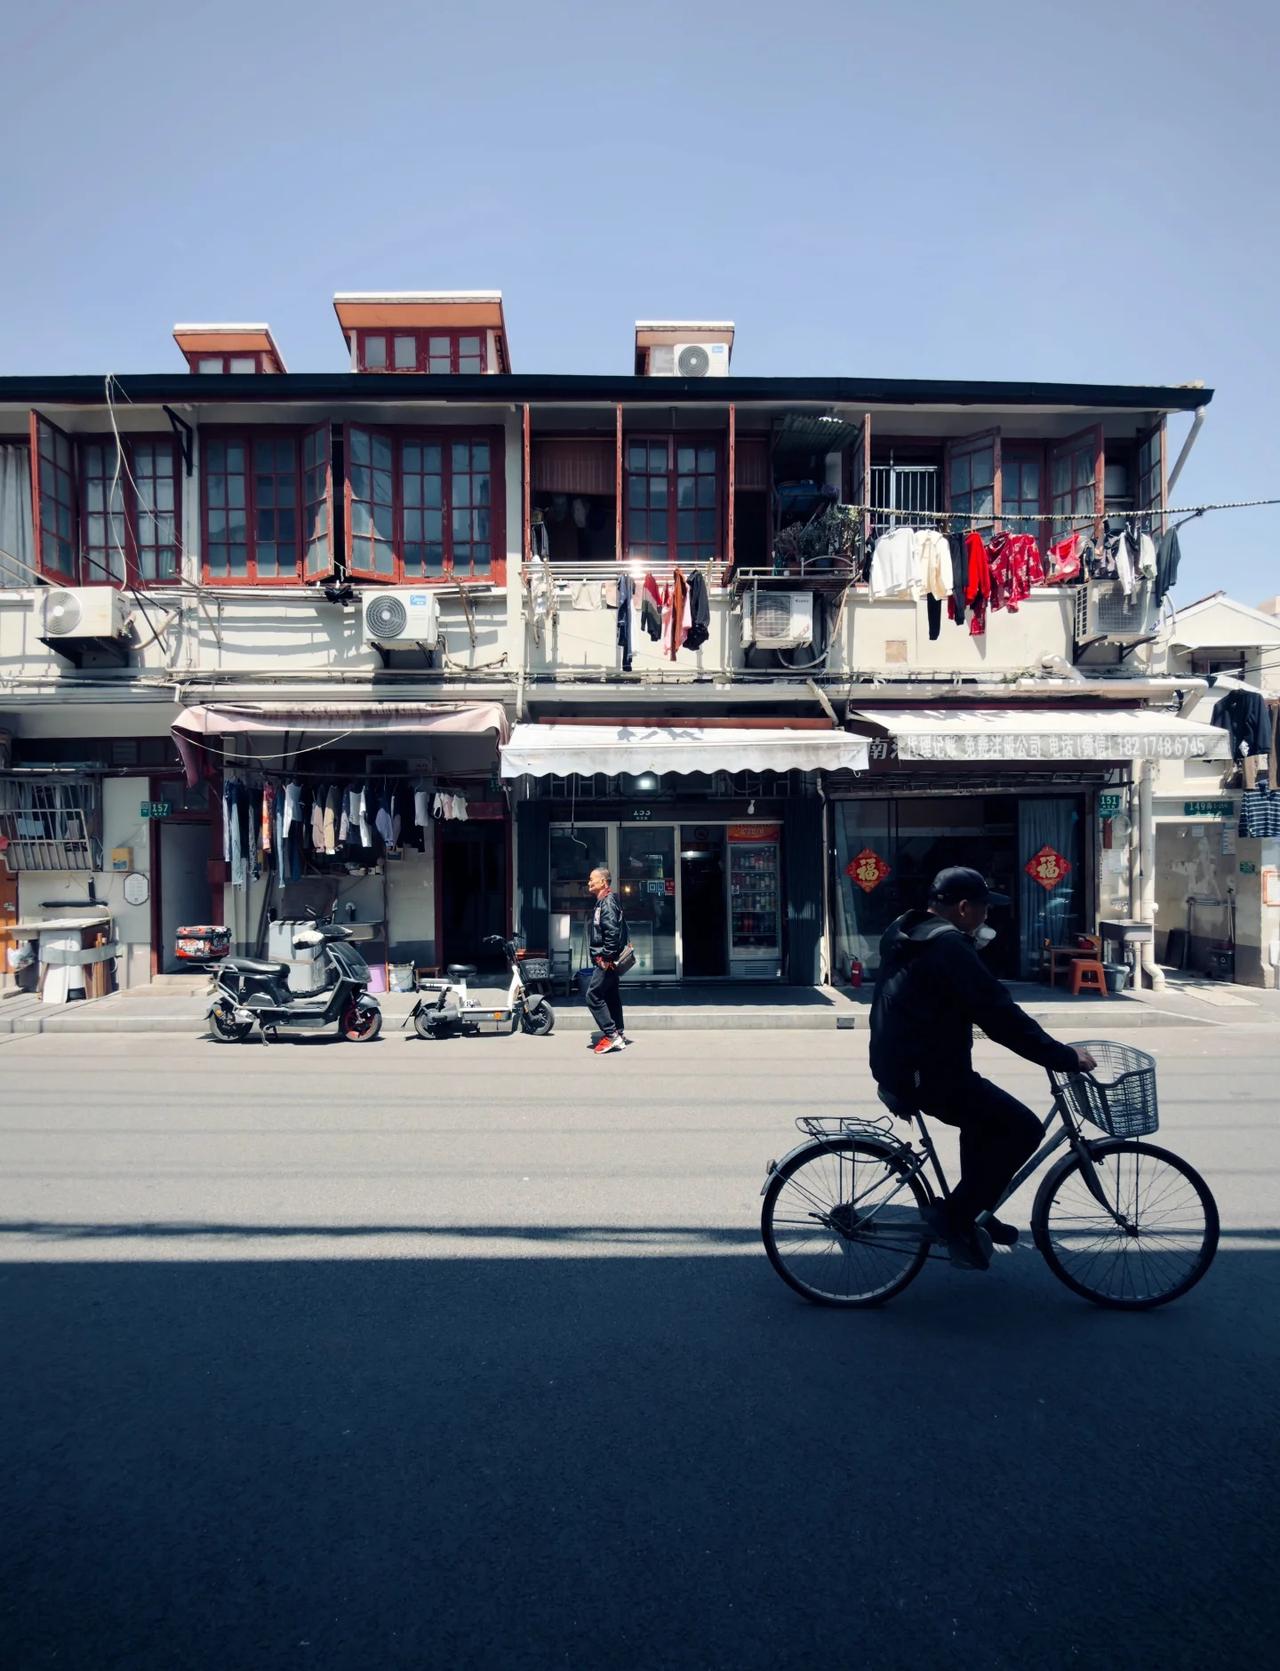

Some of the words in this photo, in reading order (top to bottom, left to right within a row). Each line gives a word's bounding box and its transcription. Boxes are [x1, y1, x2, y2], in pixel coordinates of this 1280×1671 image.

[152, 803, 168, 812] 157
[1101, 796, 1116, 805] 151
[856, 857, 879, 881] 福
[1037, 855, 1060, 879] 福
